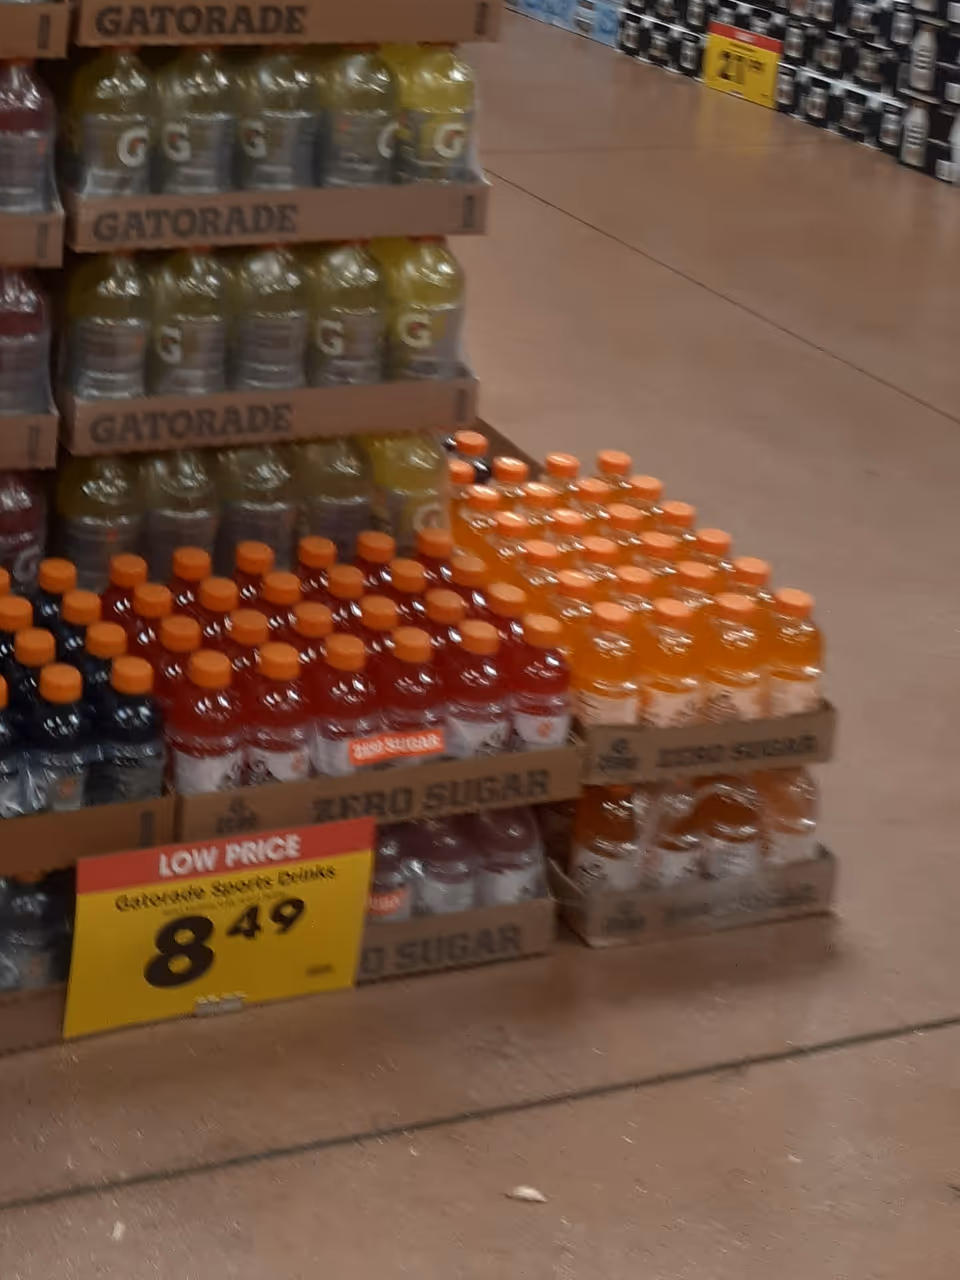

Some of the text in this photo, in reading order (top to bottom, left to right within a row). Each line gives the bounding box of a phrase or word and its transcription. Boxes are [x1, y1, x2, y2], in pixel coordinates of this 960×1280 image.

[95, 5, 307, 39] GATORADE
[117, 128, 147, 167] G
[433, 122, 465, 159] G
[93, 205, 299, 243] GATORADE
[90, 403, 294, 443] GATORADE
[384, 732, 441, 756] SUGAR
[311, 768, 550, 822] ZERO SUGAR
[159, 834, 302, 877] LOW PRICE
[113, 885, 206, 912] Gatorade
[211, 874, 273, 898] Sports
[277, 864, 337, 887] Drinks
[143, 914, 216, 989] 8
[395, 923, 522, 970] SUGAR
